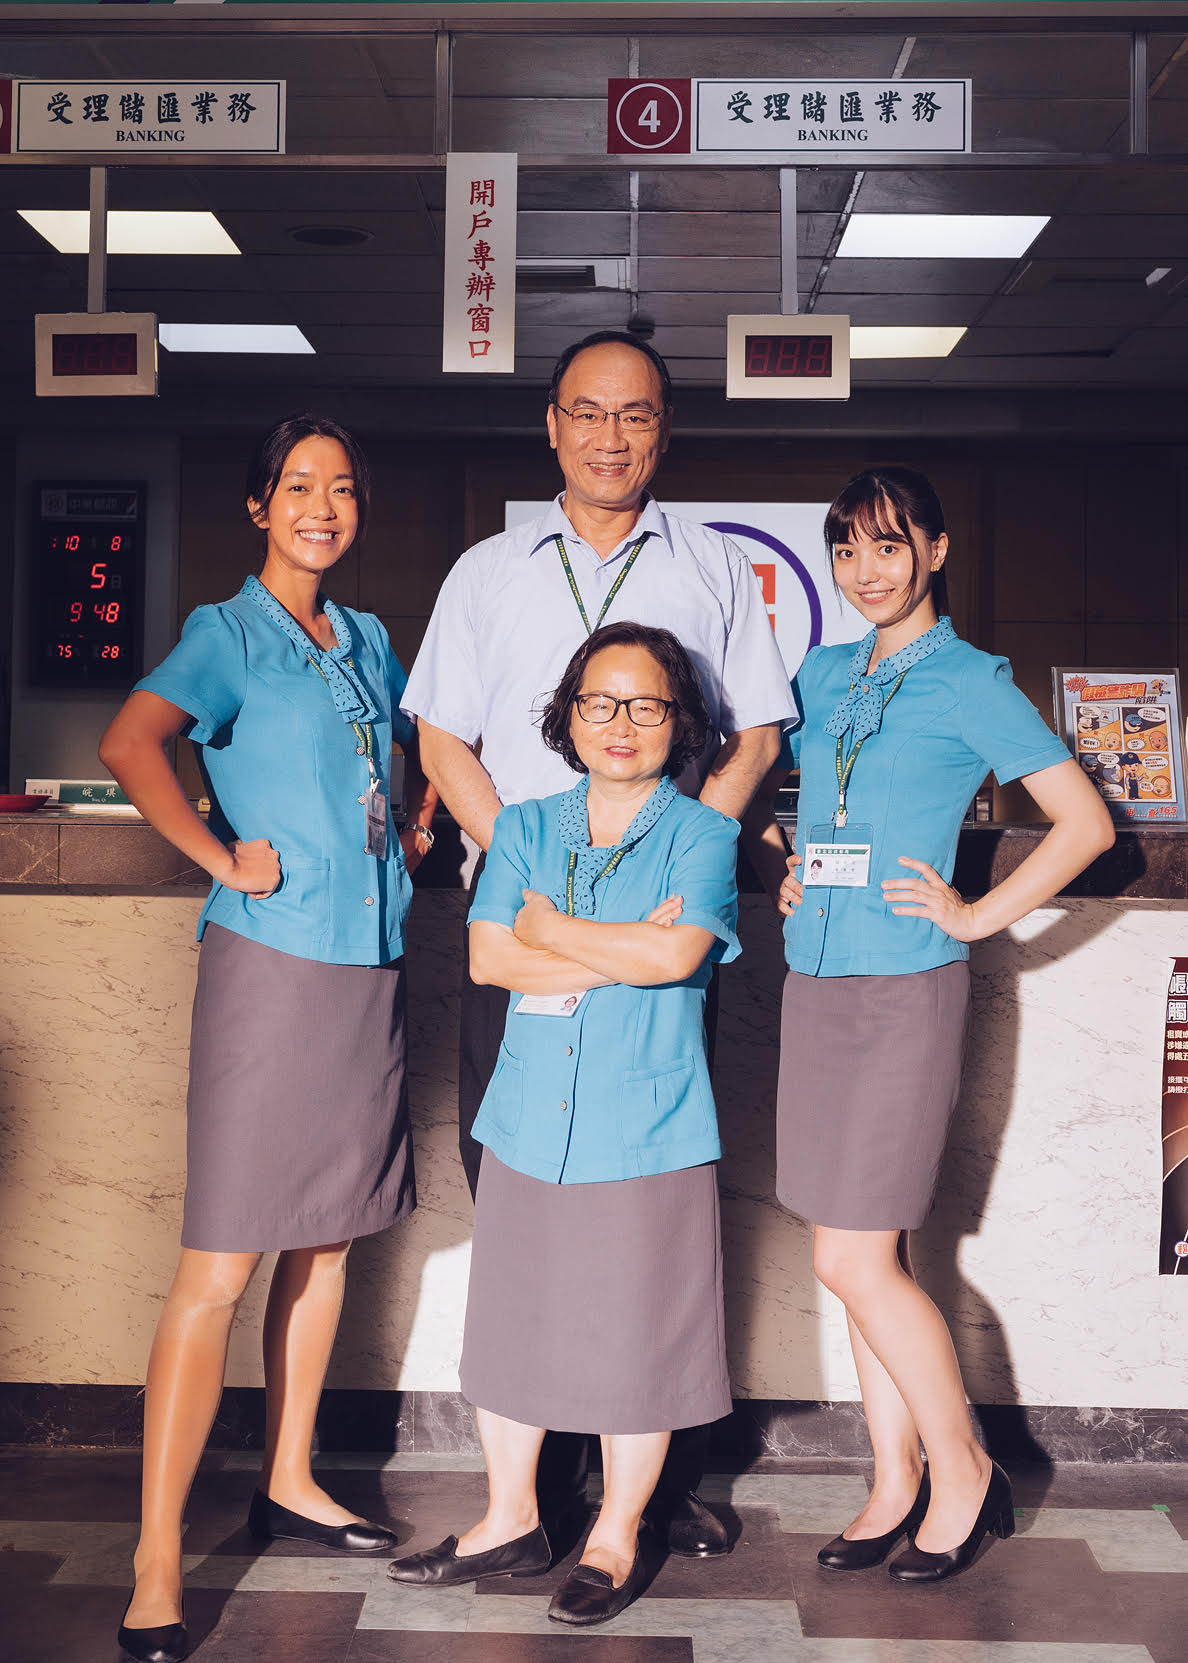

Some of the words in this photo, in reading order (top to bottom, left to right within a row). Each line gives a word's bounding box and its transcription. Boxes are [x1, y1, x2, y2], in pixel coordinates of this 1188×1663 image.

[47, 91, 257, 124] 受理儲匯業務
[638, 100, 661, 133] 4
[727, 90, 942, 124] 受理儲匯業務
[116, 130, 185, 142] BANKING
[798, 129, 868, 142] BANKING
[465, 179, 497, 359] 開戶專辦窗口
[90, 563, 107, 589] 5
[57, 645, 72, 658] 75
[101, 646, 120, 659] 28
[1159, 806, 1178, 815] 165
